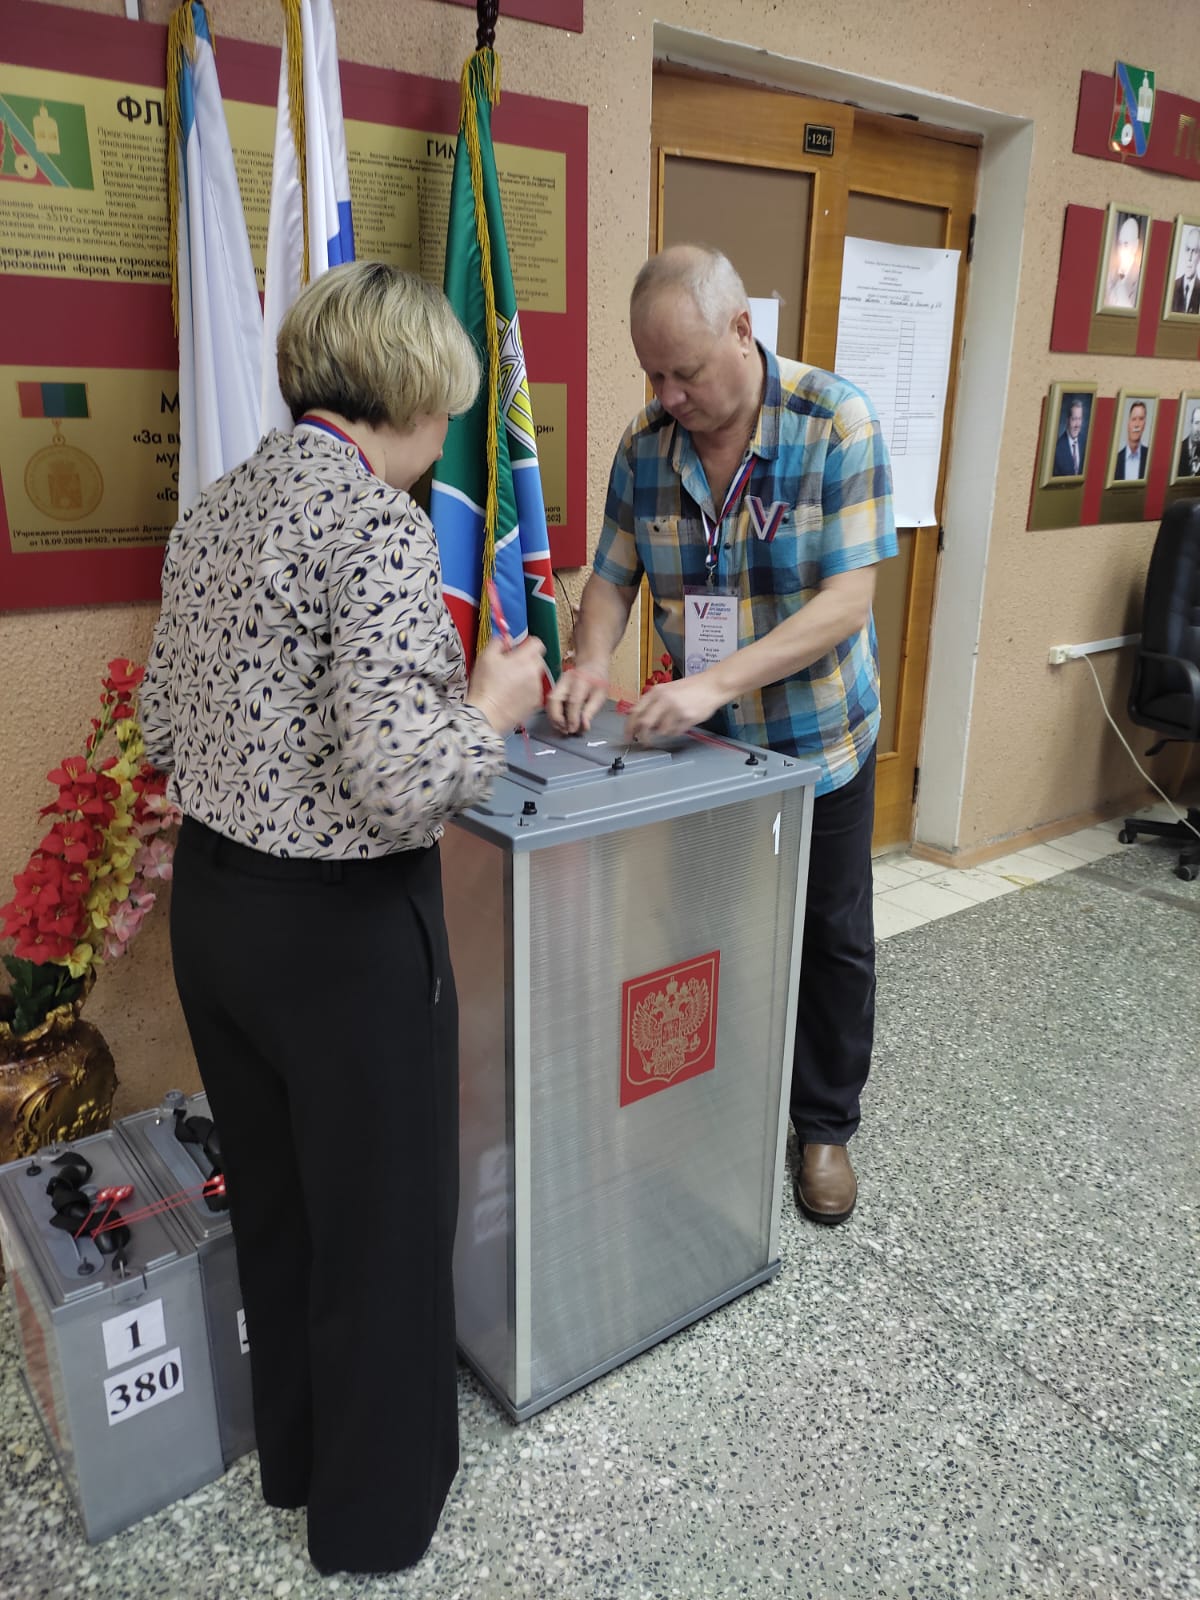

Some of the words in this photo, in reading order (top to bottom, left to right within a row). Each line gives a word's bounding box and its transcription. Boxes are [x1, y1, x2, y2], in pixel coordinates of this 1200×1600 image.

[116, 95, 164, 127] ФЛ
[812, 133, 828, 146] 126
[119, 256, 169, 269] городско
[132, 429, 162, 444] «За
[126, 1319, 144, 1352] 1
[110, 1361, 180, 1416] 380
